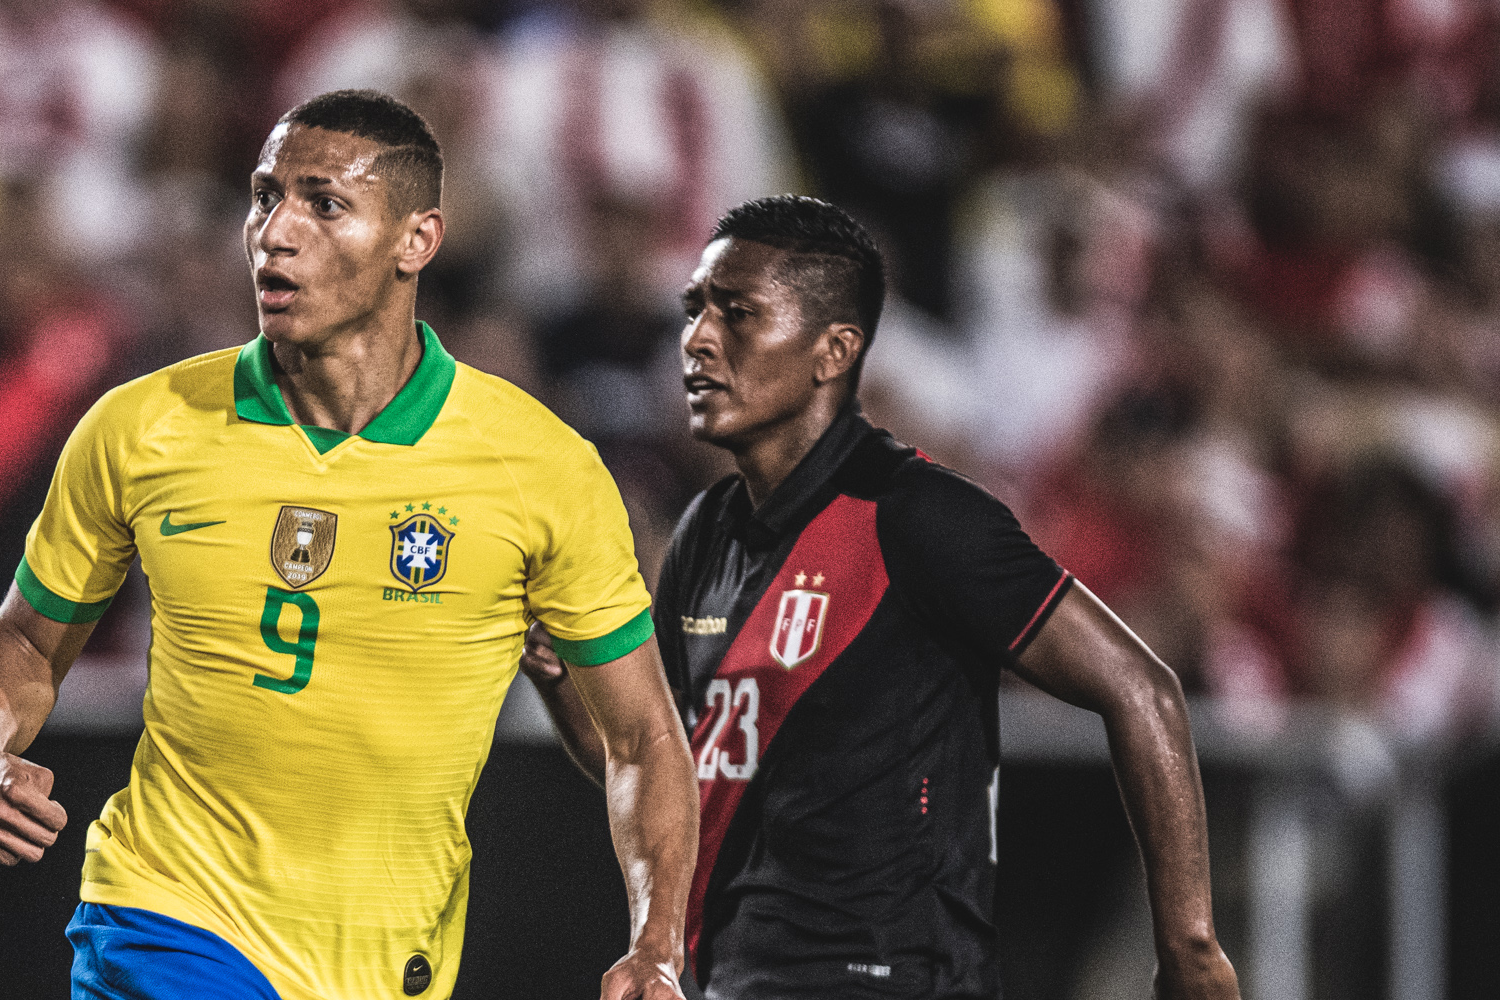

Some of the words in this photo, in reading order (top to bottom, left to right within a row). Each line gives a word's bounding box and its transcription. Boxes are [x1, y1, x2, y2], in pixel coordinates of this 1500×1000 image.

[294, 510, 322, 520] CONMEBOL
[410, 545, 431, 555] CBF
[284, 562, 313, 572] CAMPEON
[287, 572, 307, 581] 2019
[383, 587, 443, 604] BRASIL
[252, 586, 320, 695] 9
[697, 678, 760, 780] 23
